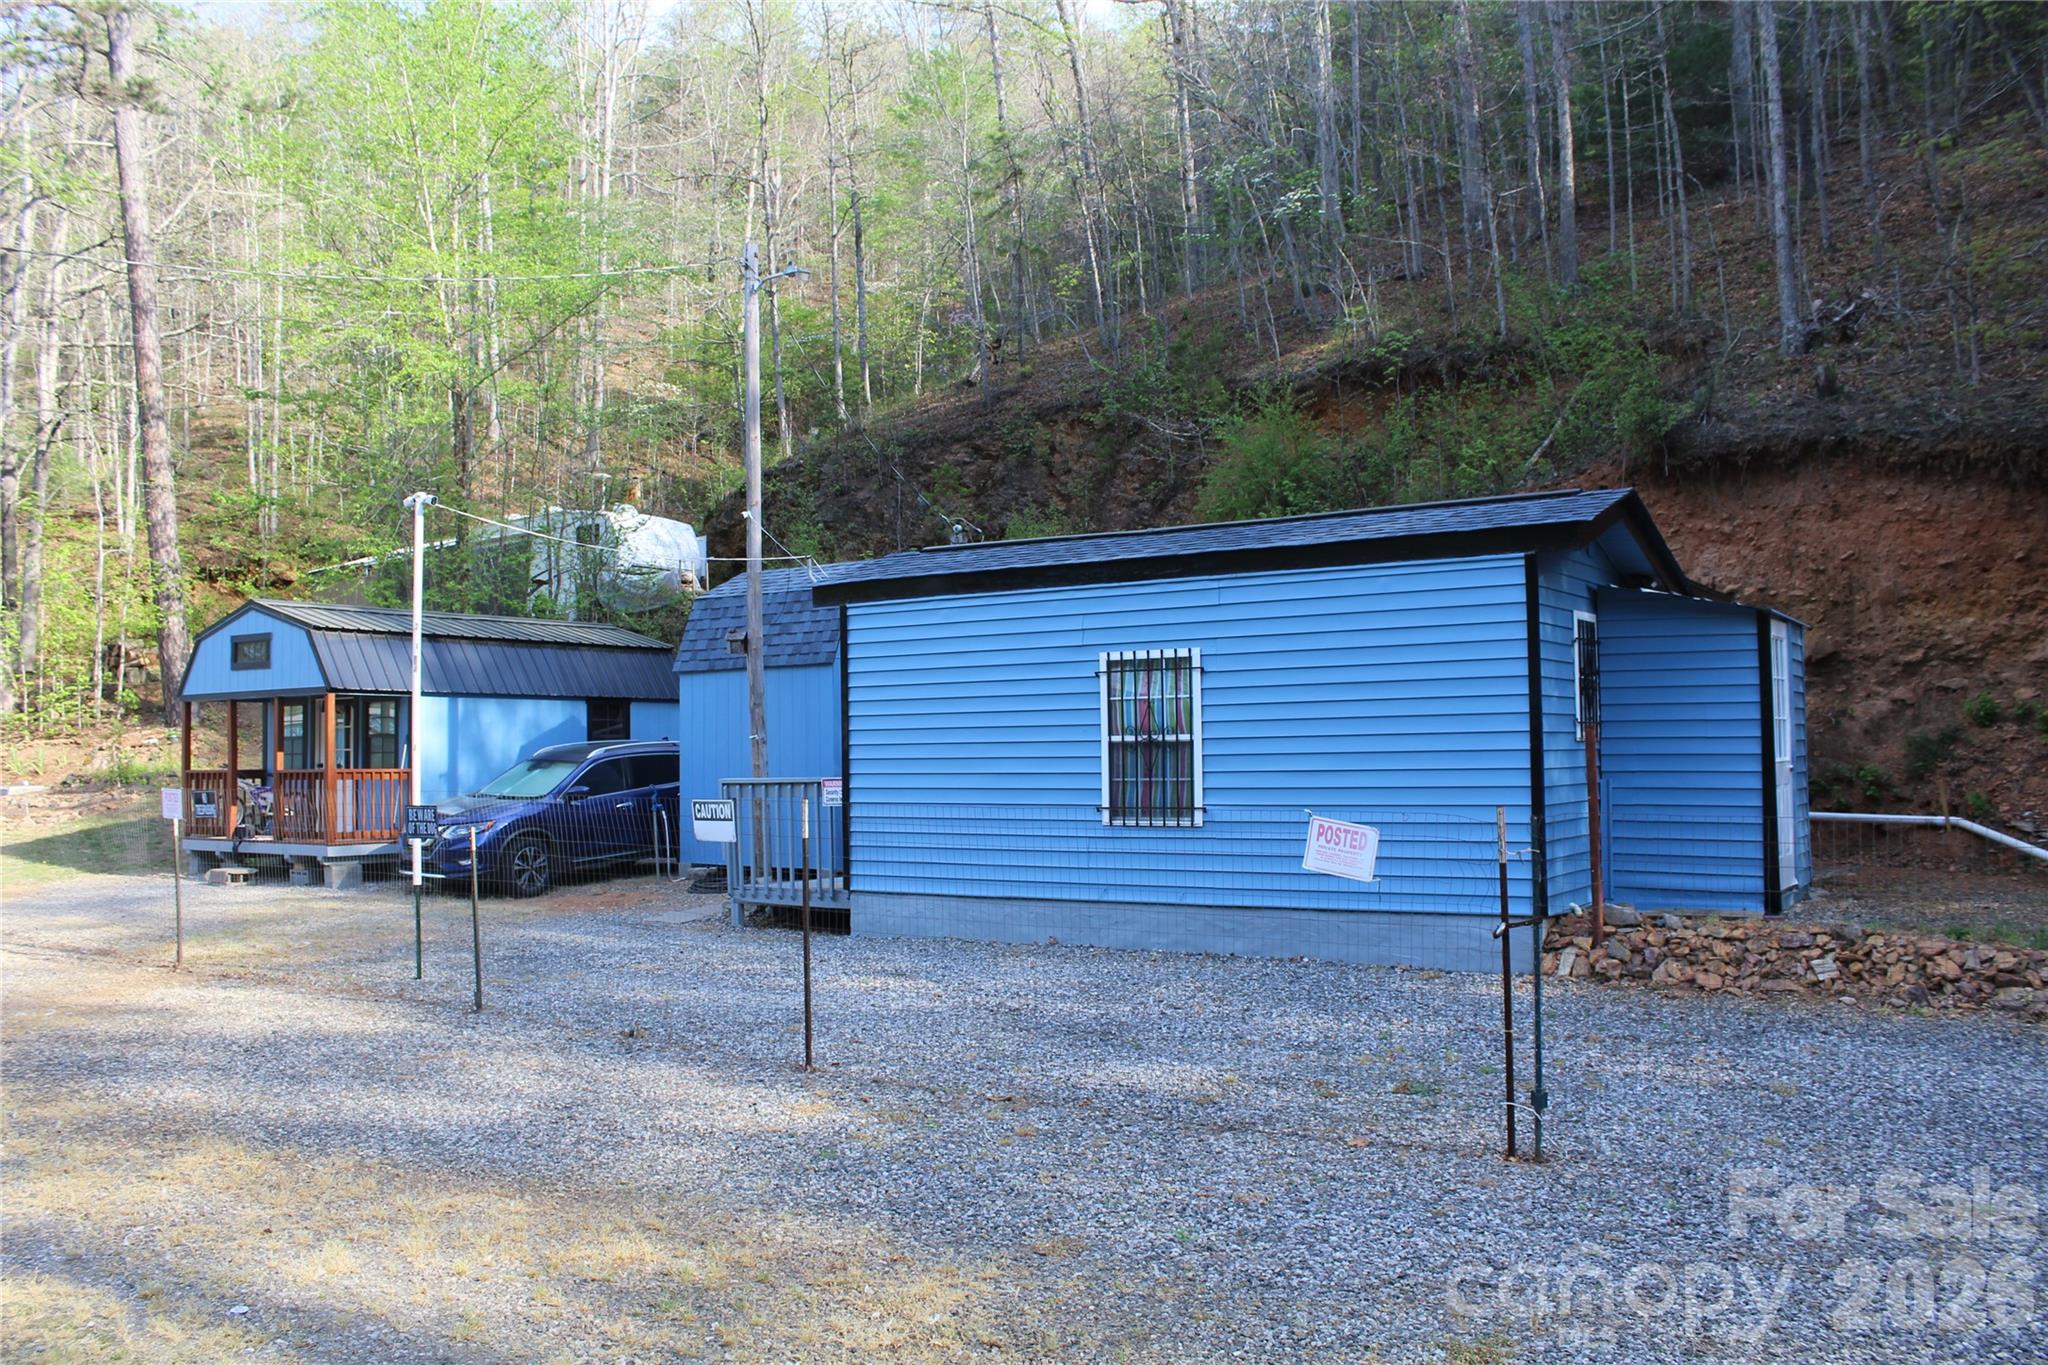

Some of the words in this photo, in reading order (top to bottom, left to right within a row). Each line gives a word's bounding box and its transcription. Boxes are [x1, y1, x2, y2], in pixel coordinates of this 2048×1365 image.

[408, 808, 435, 821] BEWARE
[695, 803, 731, 819] CAUTION
[408, 822, 415, 834] OF
[416, 822, 426, 834] THE
[1316, 823, 1368, 851] POSTED
